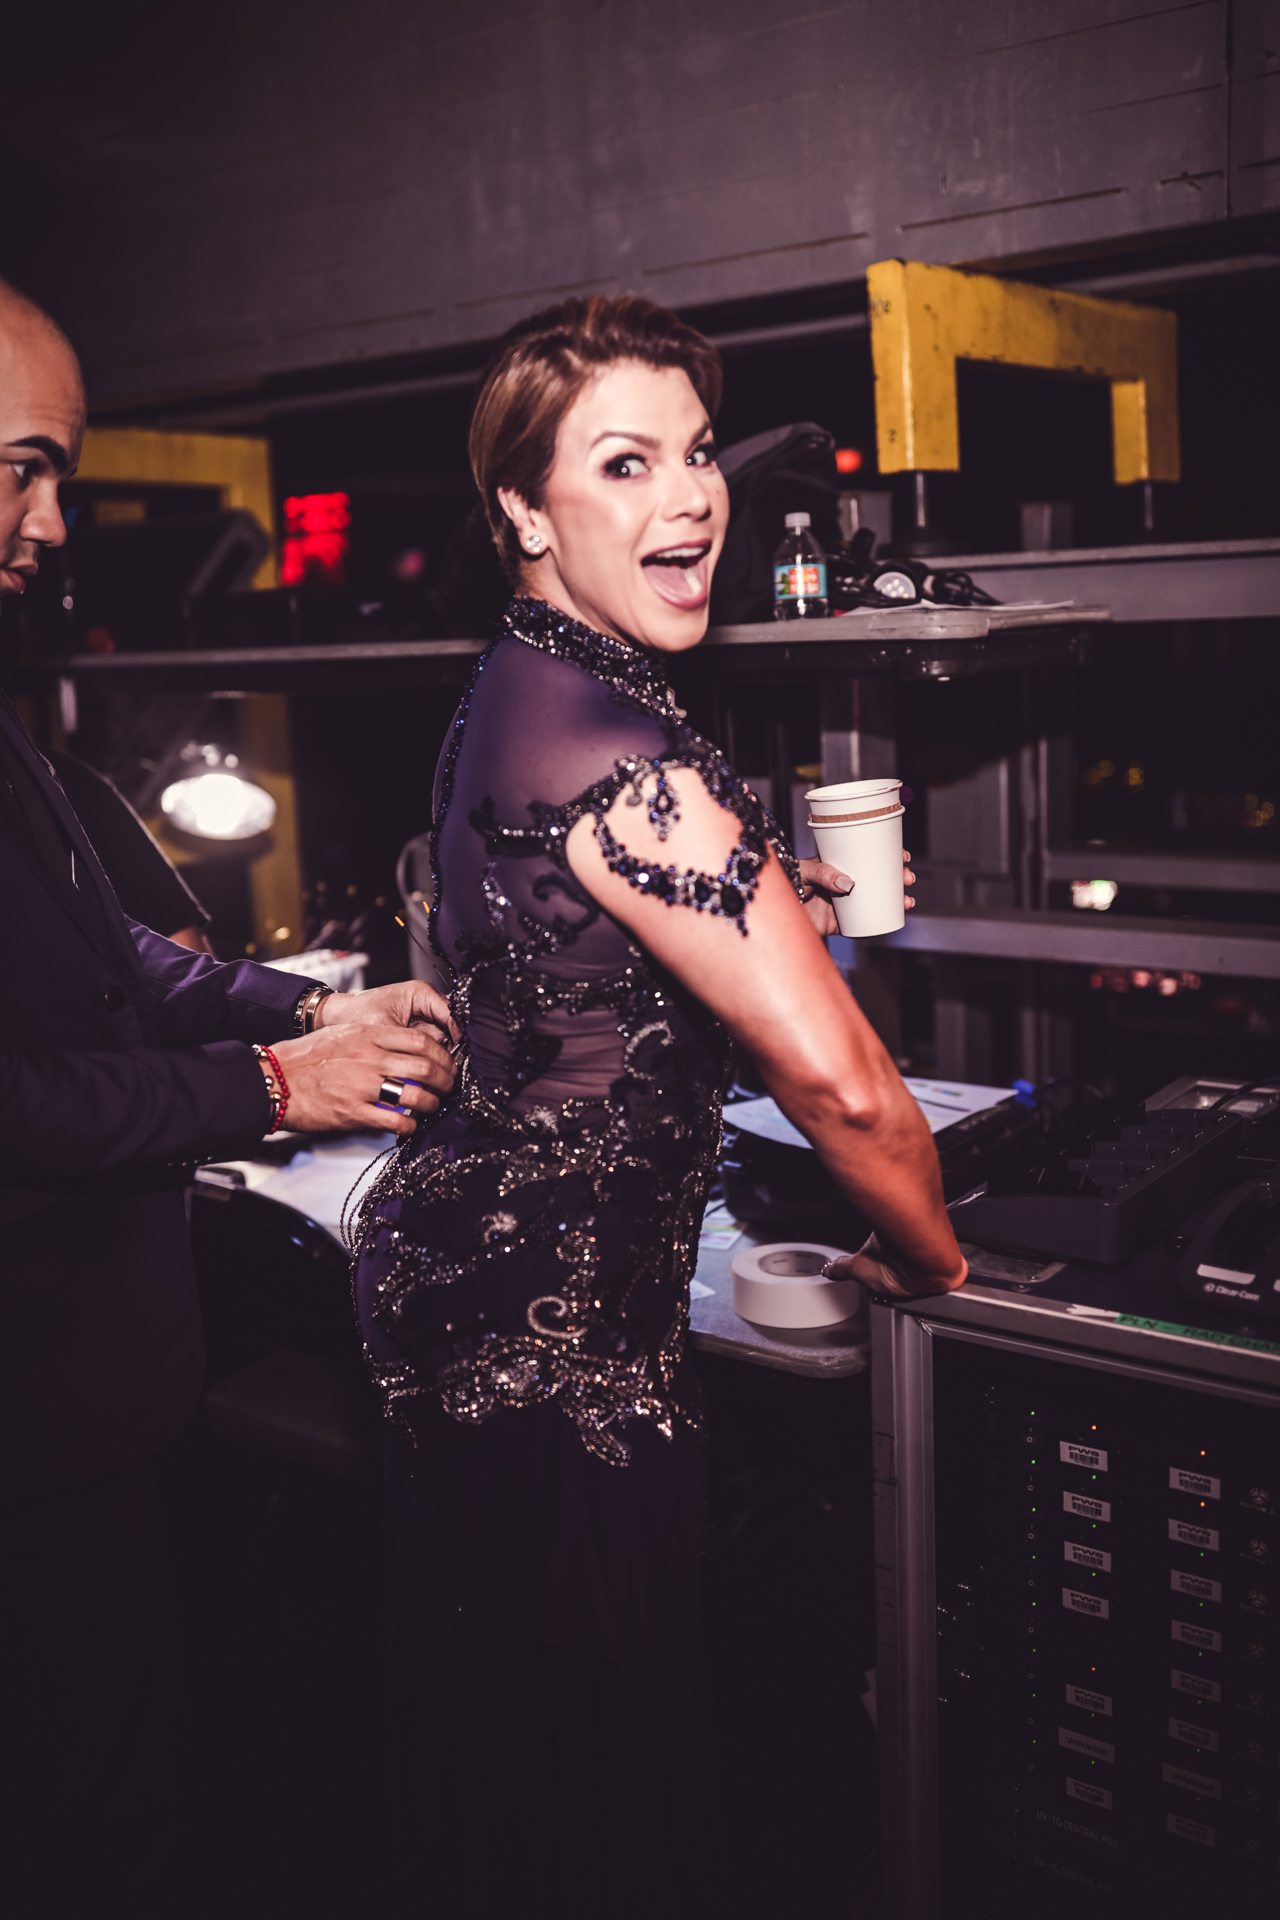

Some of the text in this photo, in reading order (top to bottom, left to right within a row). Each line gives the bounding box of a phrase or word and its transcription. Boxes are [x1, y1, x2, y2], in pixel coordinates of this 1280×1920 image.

[1066, 1735, 1108, 1756] Univision
[1036, 1809, 1119, 1848] UV-1G CENTRAL PSU
[1059, 1866, 1095, 1889] CENTRAL
